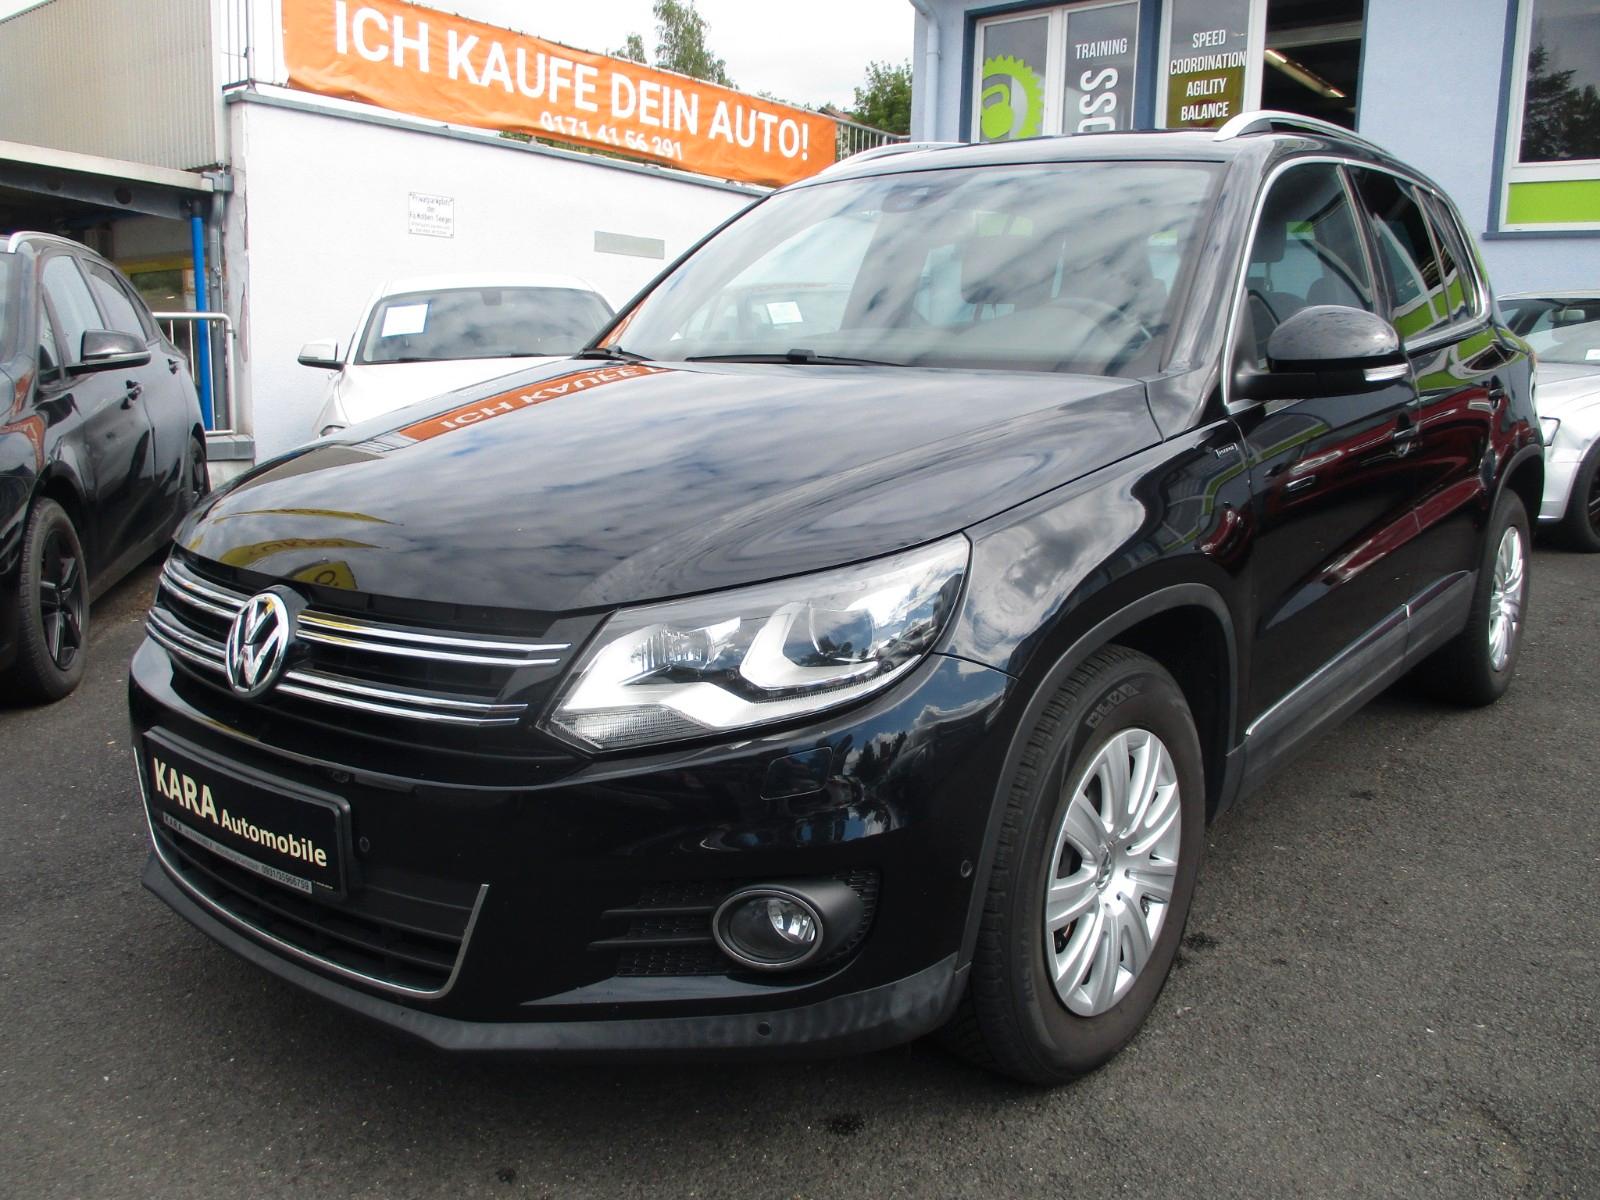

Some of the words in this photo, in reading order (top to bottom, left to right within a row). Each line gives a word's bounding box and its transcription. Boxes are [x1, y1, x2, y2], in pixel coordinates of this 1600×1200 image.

[1075, 37, 1128, 60] TRAINING
[1192, 29, 1227, 48] SPEED
[1170, 51, 1247, 76] COORDINATION
[335, 0, 430, 73] ICH
[447, 29, 599, 113] KAUFE
[611, 72, 699, 135] DEIN
[708, 101, 809, 160] AUTO!
[1186, 77, 1227, 97] AGILITY
[1180, 101, 1229, 121] BALANCE
[540, 111, 593, 140] 0171
[596, 124, 620, 146] 41
[625, 130, 649, 153] 56
[652, 136, 683, 161] 291
[153, 757, 219, 824] KARA
[221, 809, 328, 867] Automobile
